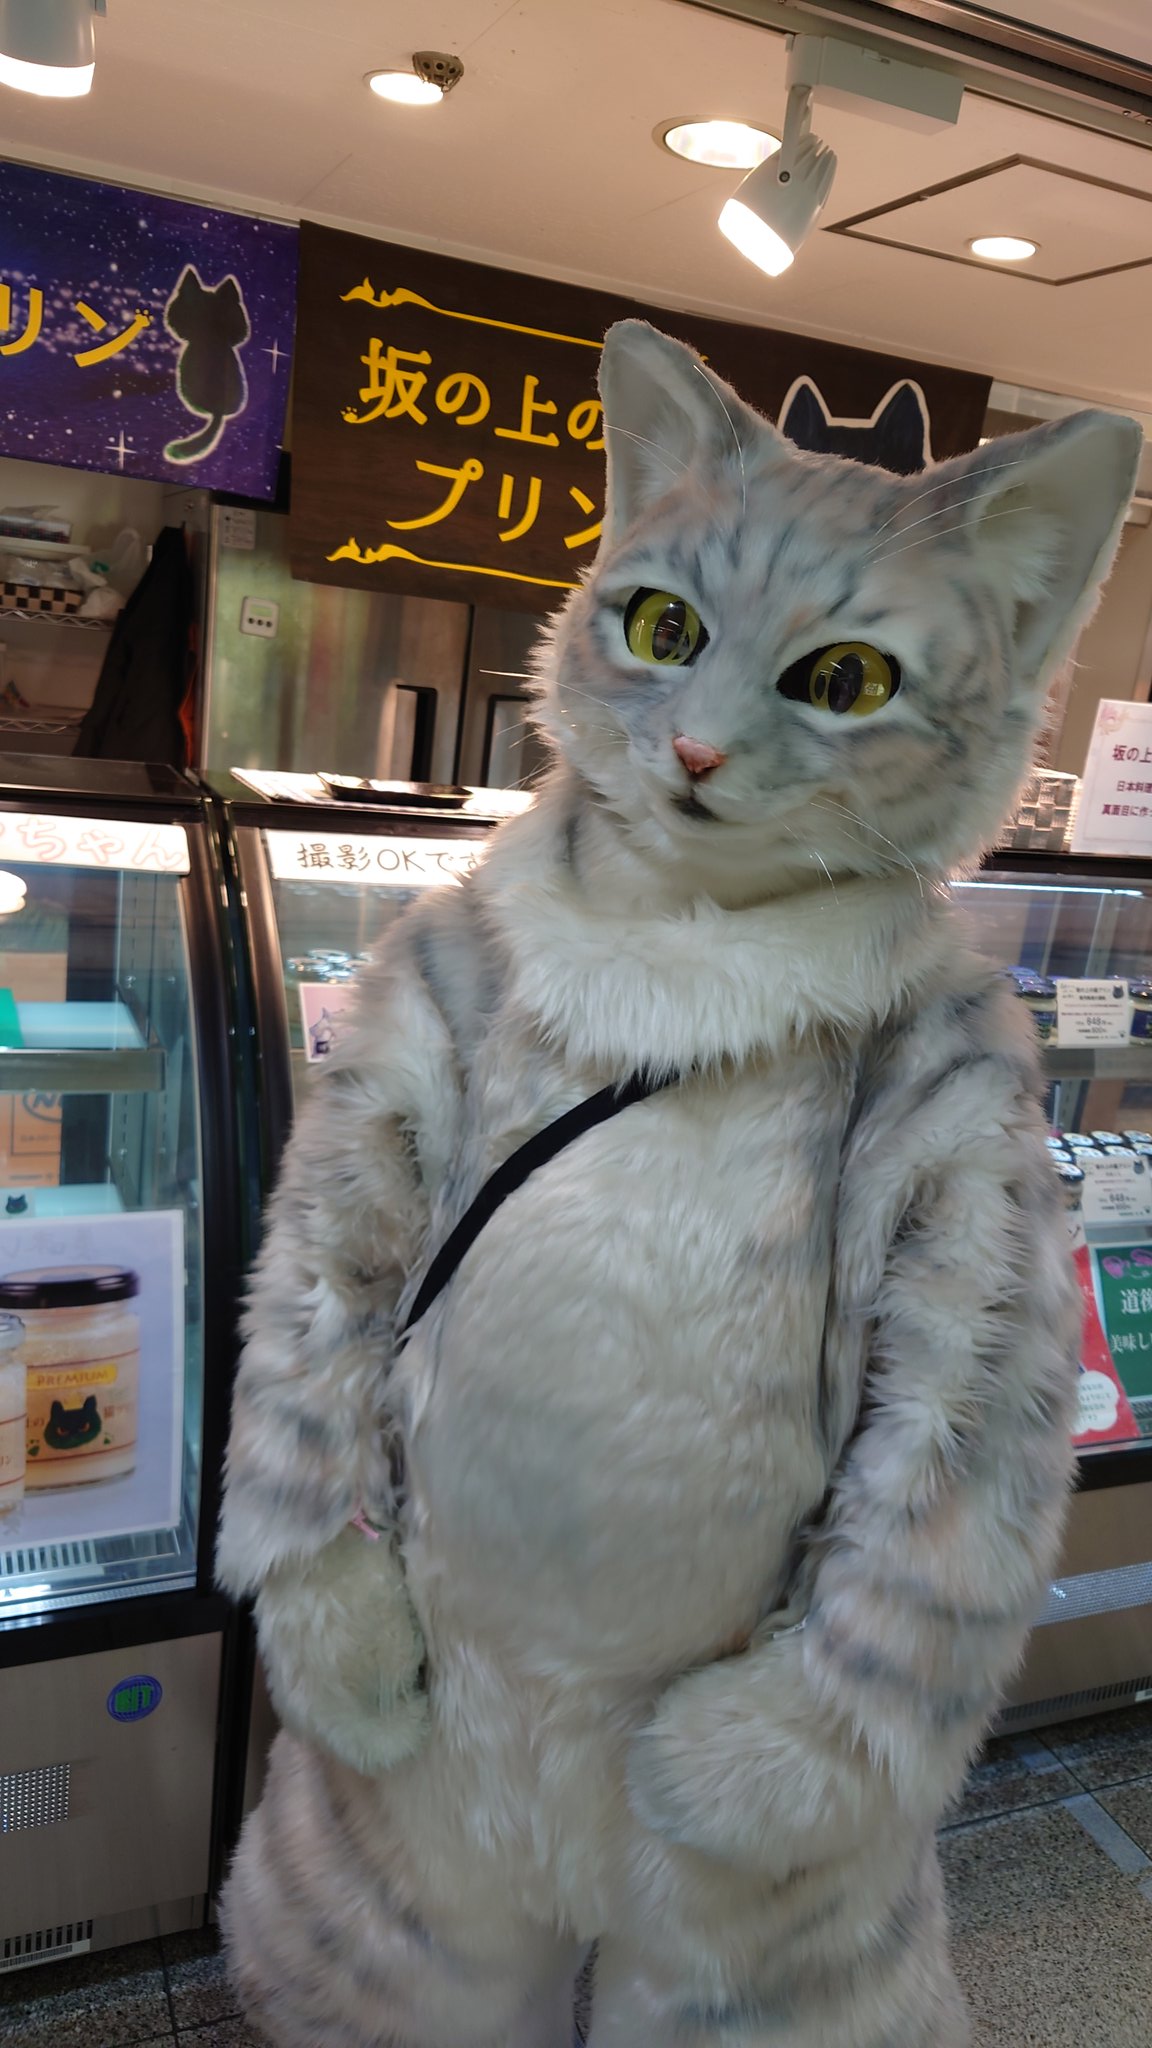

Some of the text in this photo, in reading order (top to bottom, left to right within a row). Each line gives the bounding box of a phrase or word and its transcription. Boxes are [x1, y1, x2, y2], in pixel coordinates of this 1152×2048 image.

[1102, 803, 1152, 817] 真面目に作
[0, 817, 184, 868] ちゃん
[1111, 1332, 1152, 1353] 美味し
[37, 1369, 109, 1386] PREMIUM
